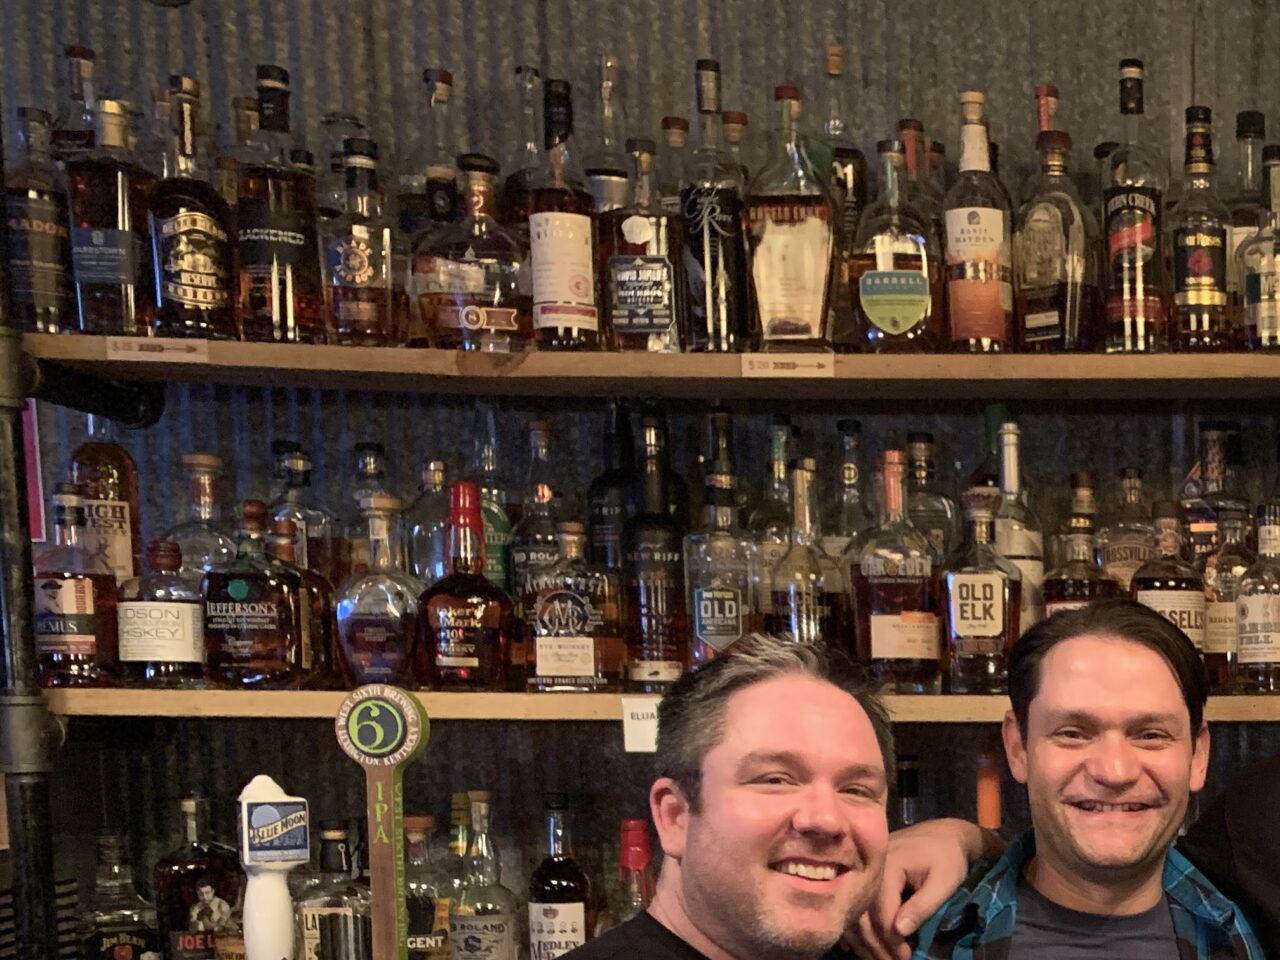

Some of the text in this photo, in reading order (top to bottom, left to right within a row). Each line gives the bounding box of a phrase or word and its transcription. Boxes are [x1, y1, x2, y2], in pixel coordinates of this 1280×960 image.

[86, 503, 125, 519] IGH
[91, 518, 127, 529] EST
[959, 583, 995, 601] OLD
[206, 601, 278, 617] JEFFERSON'S
[700, 600, 737, 617] OLD
[959, 602, 996, 621] ELK
[251, 811, 306, 845] BLUE MOON
[460, 922, 505, 935] ROLAND
[177, 934, 204, 951] JOE
